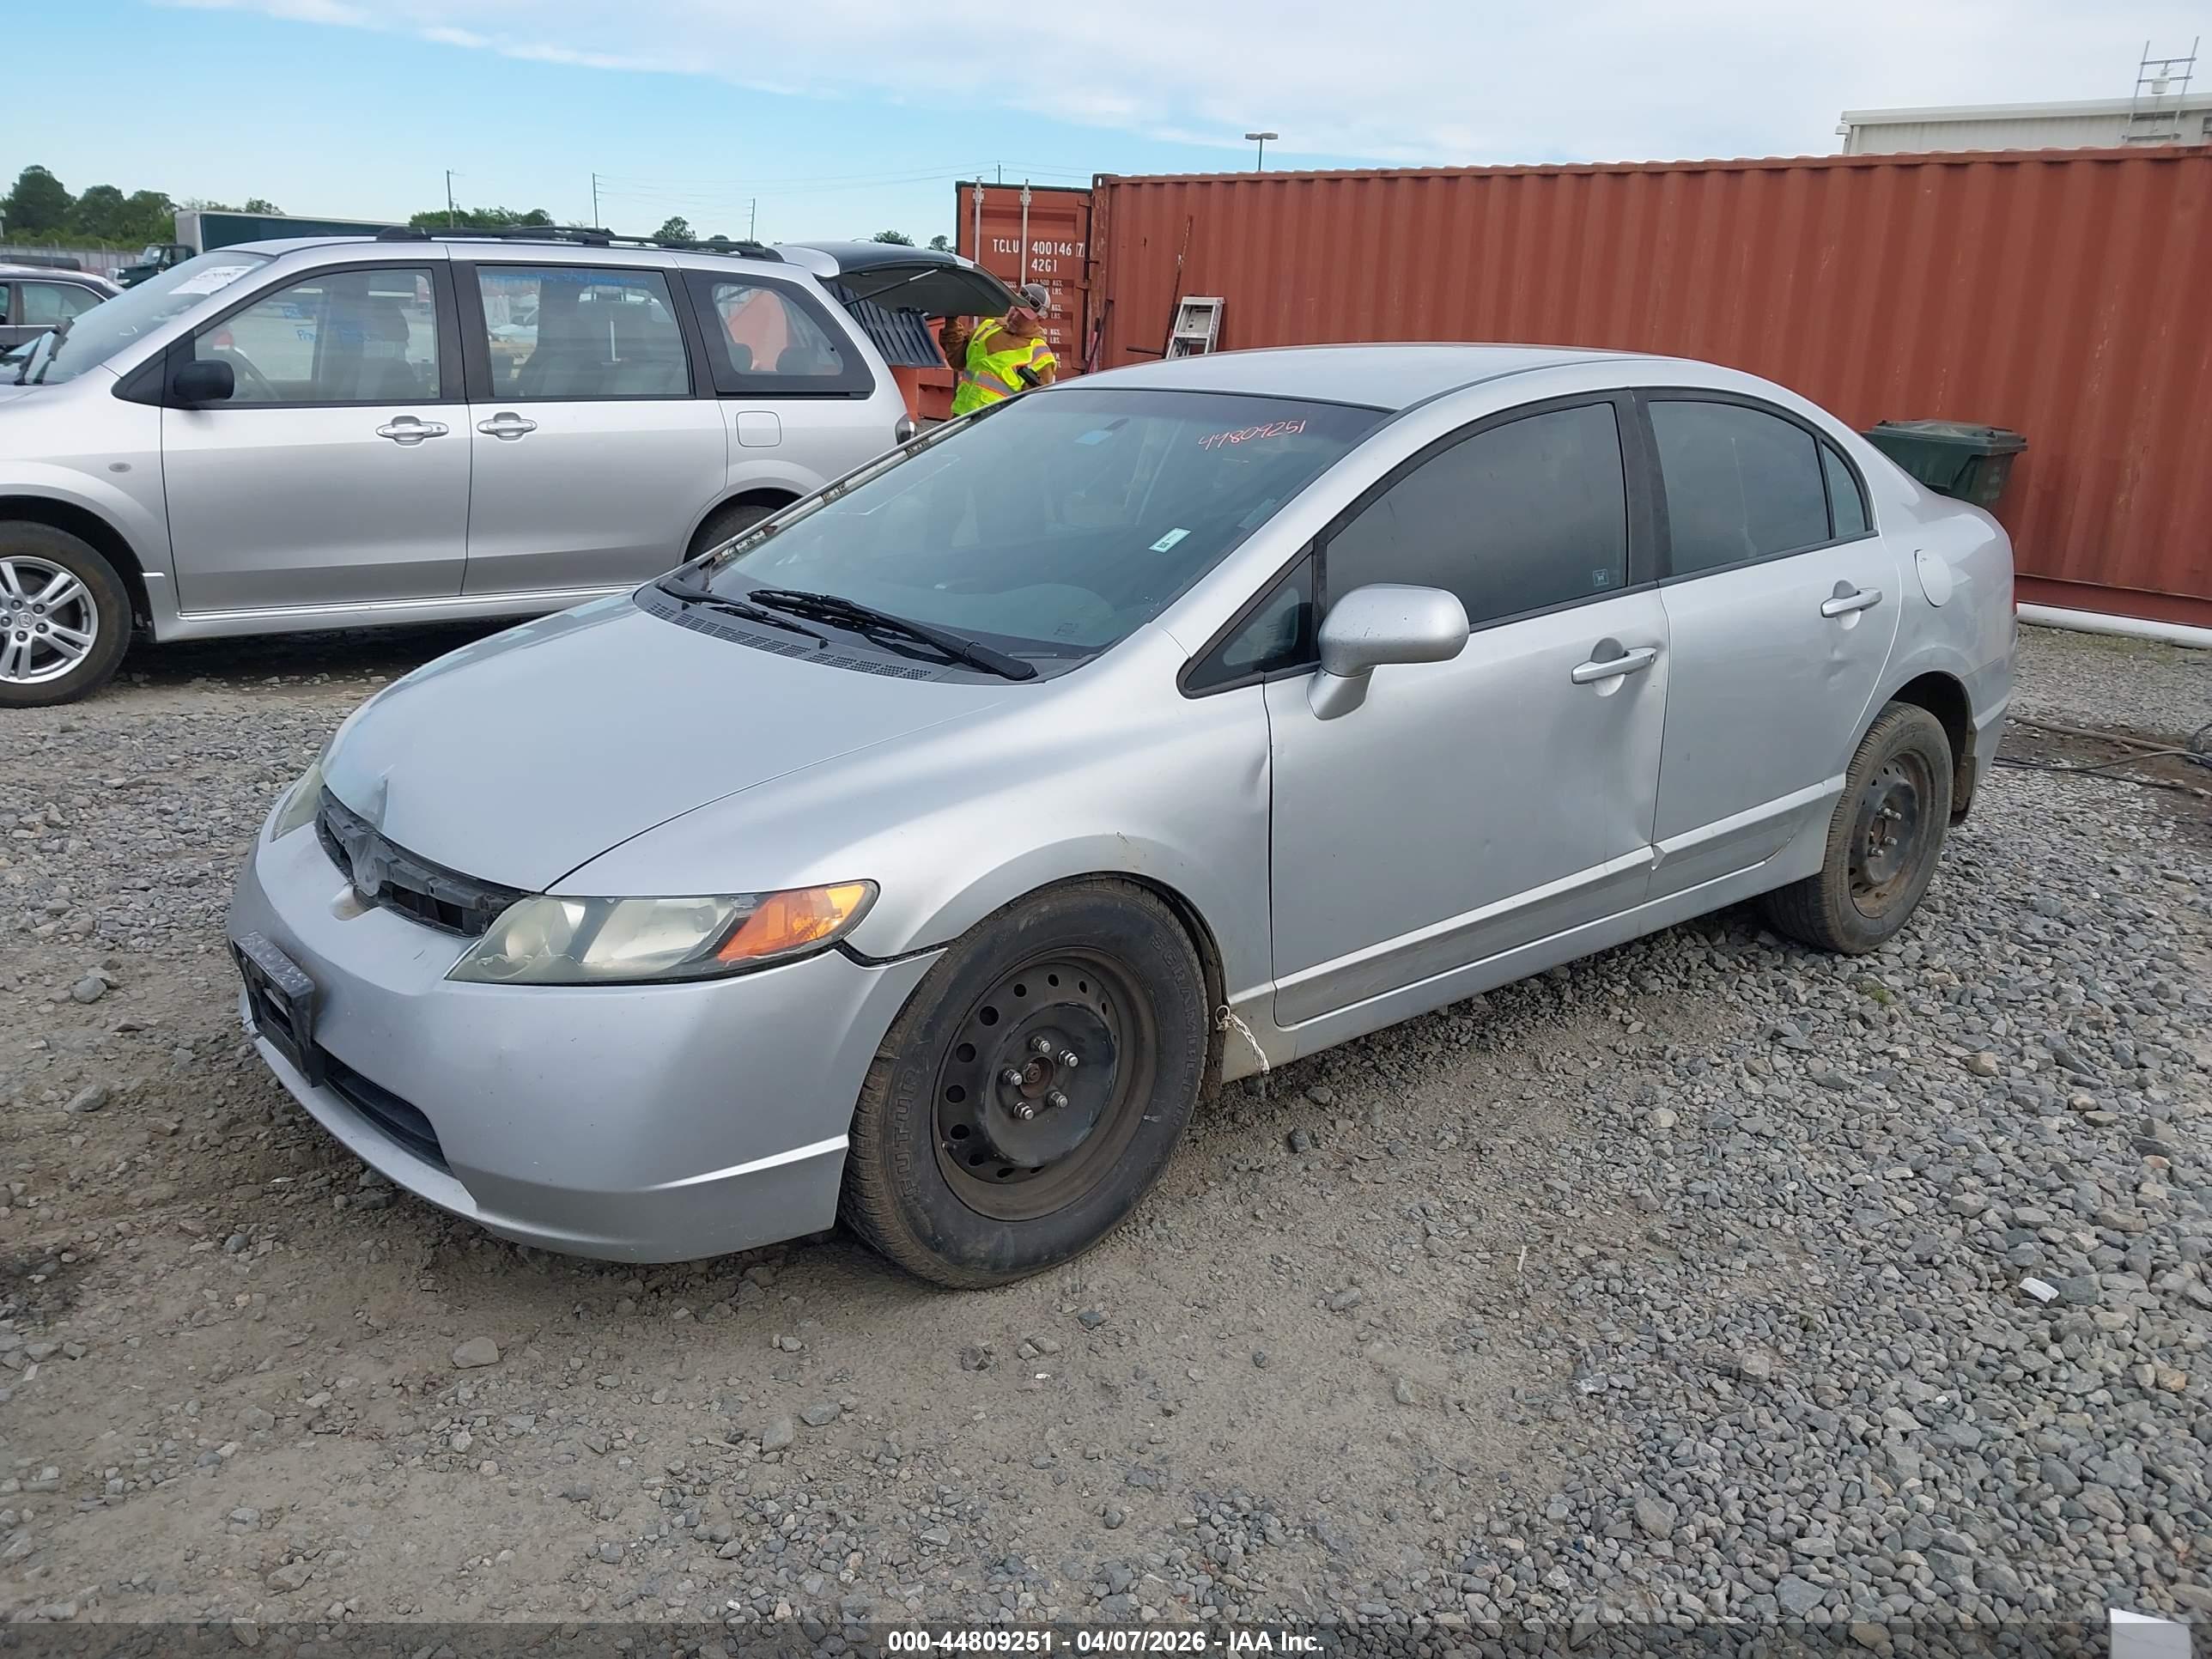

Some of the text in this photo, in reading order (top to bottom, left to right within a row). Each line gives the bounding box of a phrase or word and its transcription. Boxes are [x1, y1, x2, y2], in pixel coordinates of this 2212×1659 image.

[993, 239, 1019, 253] TCLU
[1031, 240, 1073, 257] 400146
[1030, 258, 1057, 272] 42G1
[1198, 419, 1306, 450] 44809251
